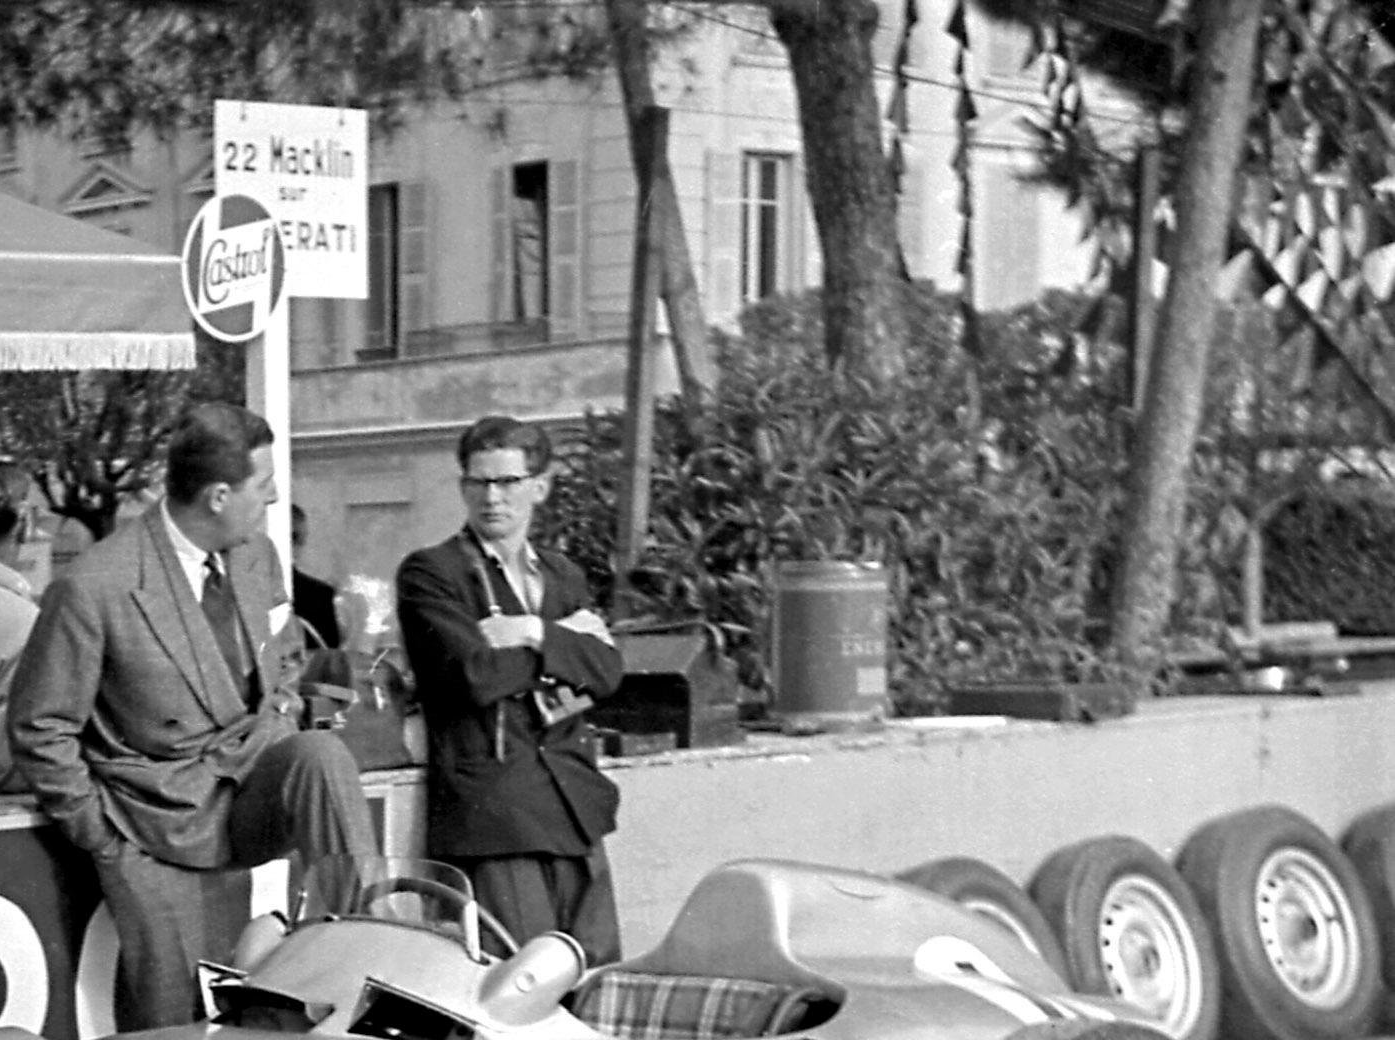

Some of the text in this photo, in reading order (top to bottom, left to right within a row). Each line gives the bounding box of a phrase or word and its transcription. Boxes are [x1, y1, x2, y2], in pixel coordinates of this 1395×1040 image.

[224, 136, 354, 178] 22 Macklin
[279, 186, 307, 201] sur
[280, 219, 357, 252] ERATI
[203, 227, 271, 304] Castrol
